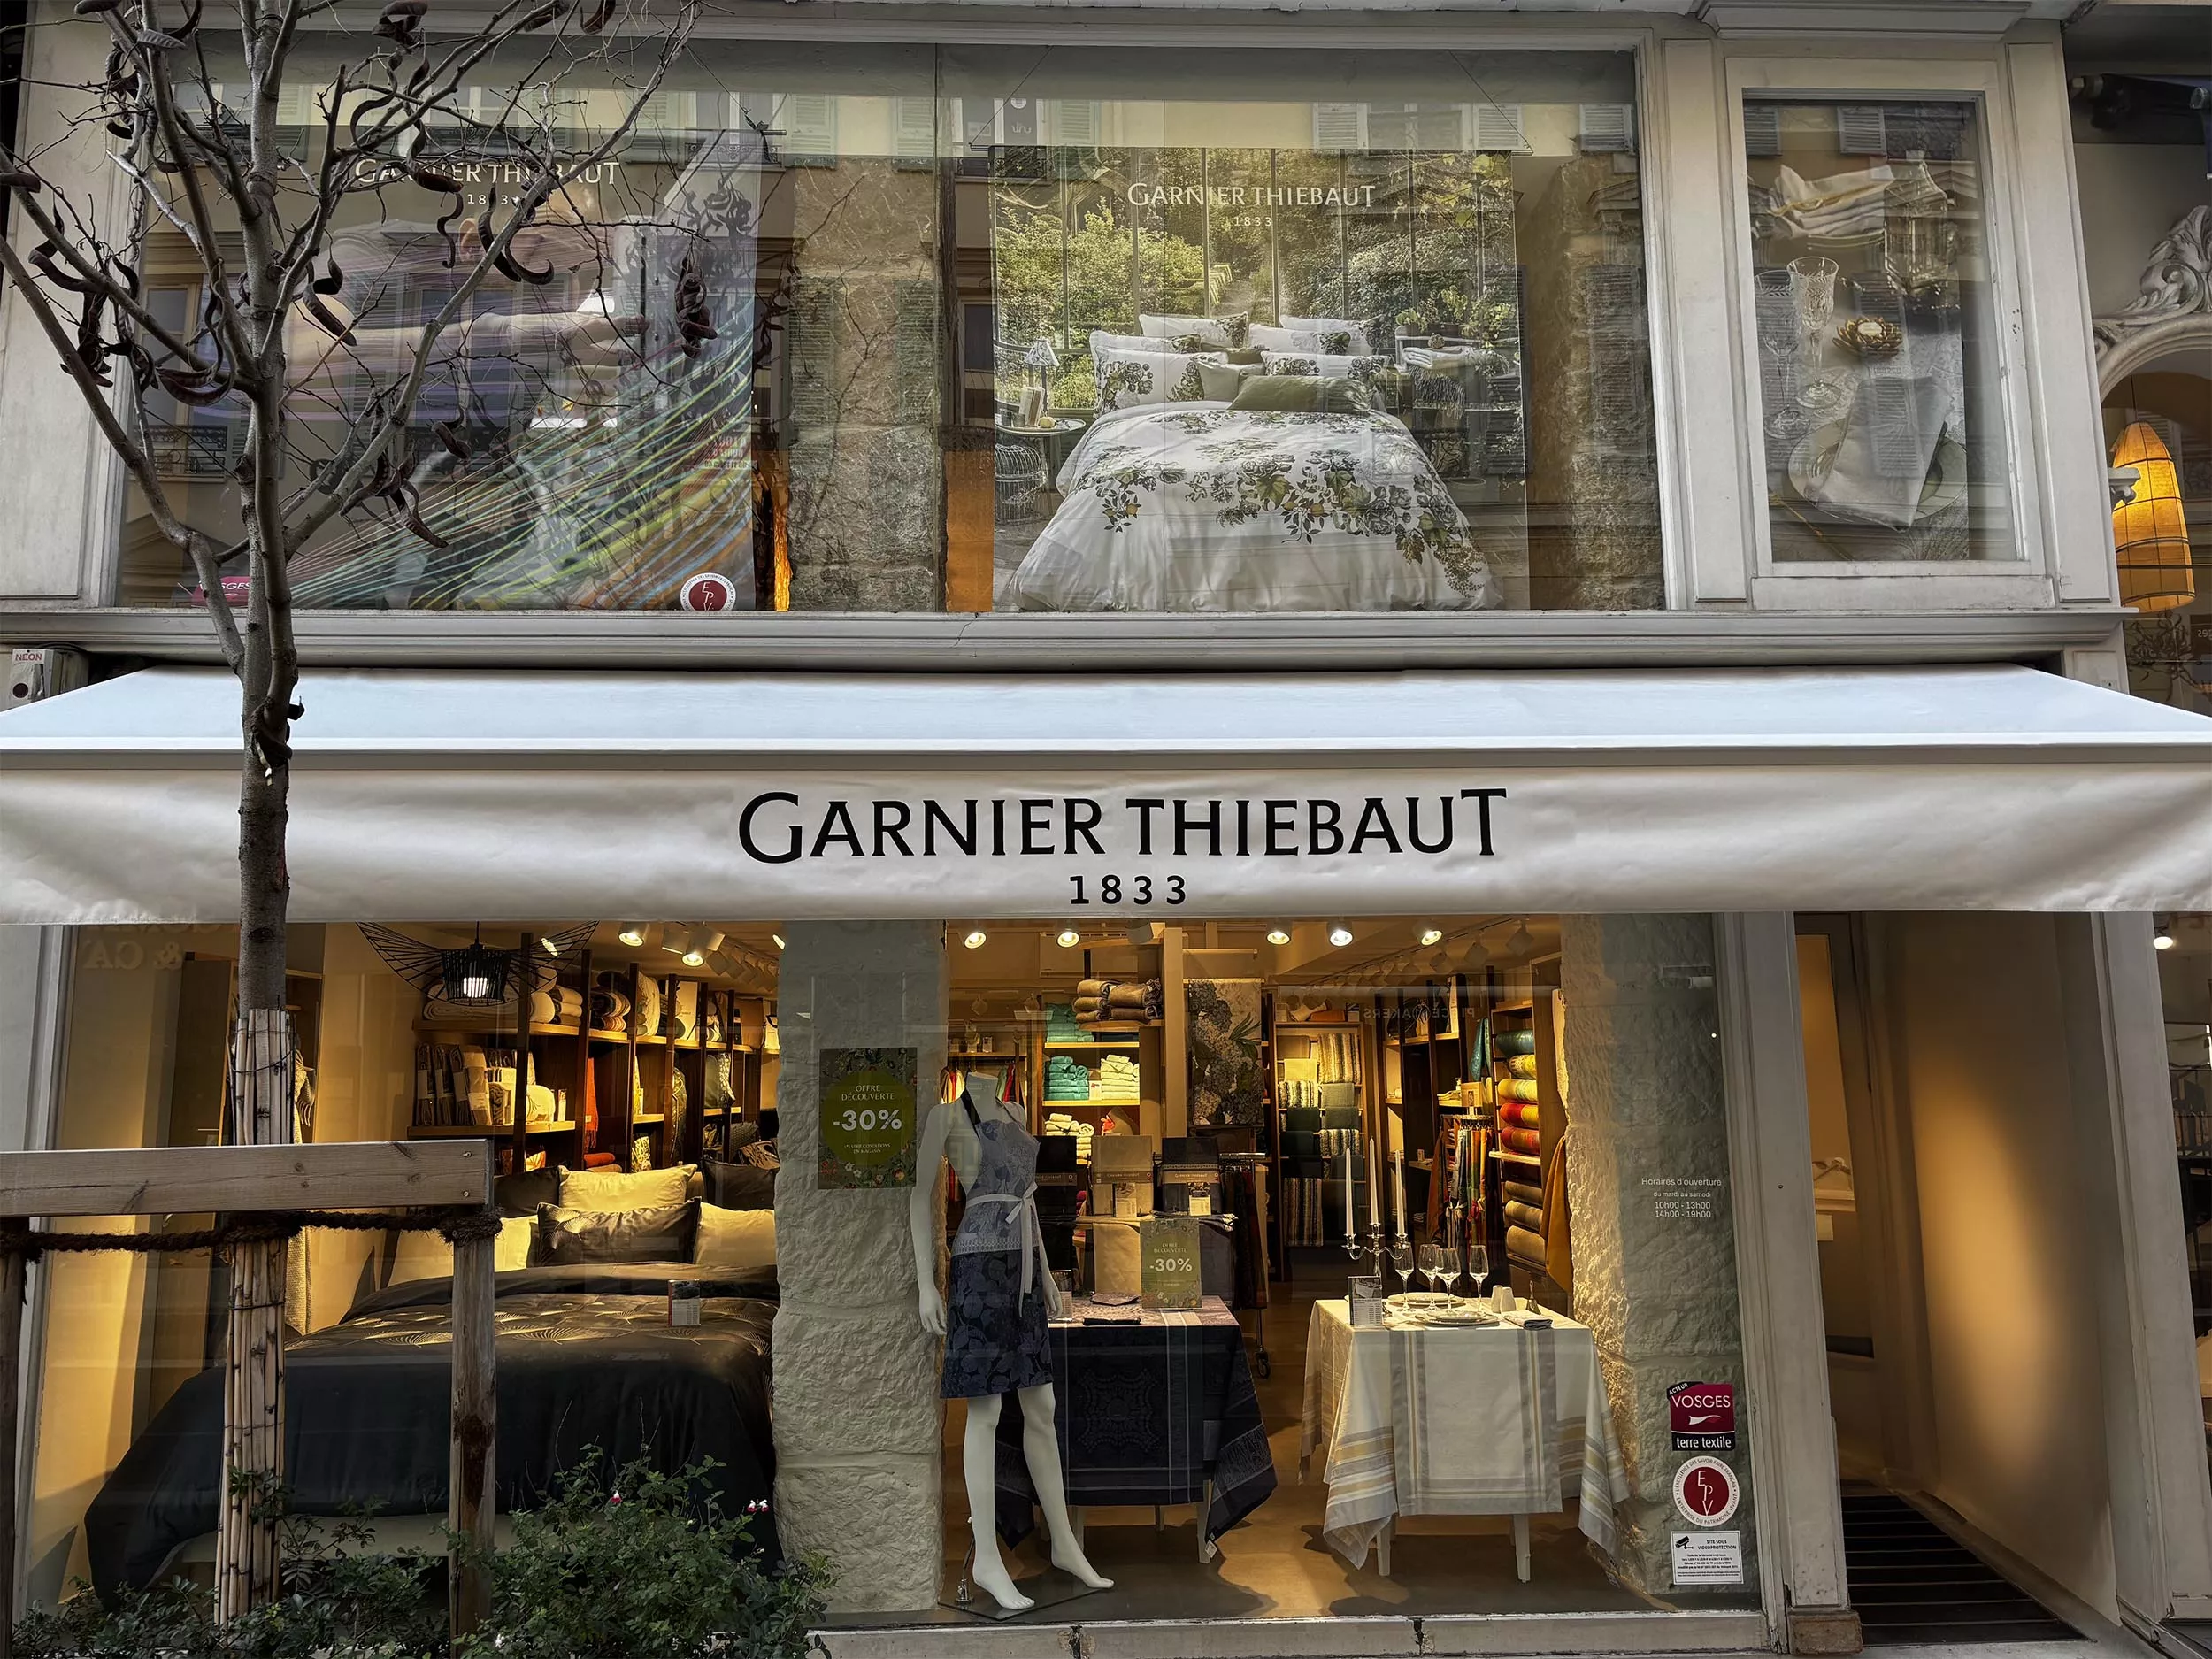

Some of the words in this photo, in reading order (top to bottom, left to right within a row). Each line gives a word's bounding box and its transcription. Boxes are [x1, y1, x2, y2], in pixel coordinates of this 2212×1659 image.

[466, 194, 509, 205] 183
[1127, 182, 1246, 206] GARNIER
[1253, 185, 1376, 208] THIEBAUT
[1233, 216, 1272, 227] 1833
[738, 790, 1107, 864] GARNIER
[1125, 788, 1508, 856] THIEBAUT
[1069, 874, 1187, 906] 1833
[841, 1091, 895, 1102] DÉCOUVERTE
[833, 1109, 902, 1131] -30%
[1677, 1177, 1722, 1187] d'ouverture
[1149, 1258, 1193, 1272] -30%
[1669, 1382, 1688, 1396] ACTEUR
[1671, 1394, 1732, 1408] VOSGES
[1676, 1436, 1699, 1448] terre
[1701, 1435, 1732, 1448] textile
